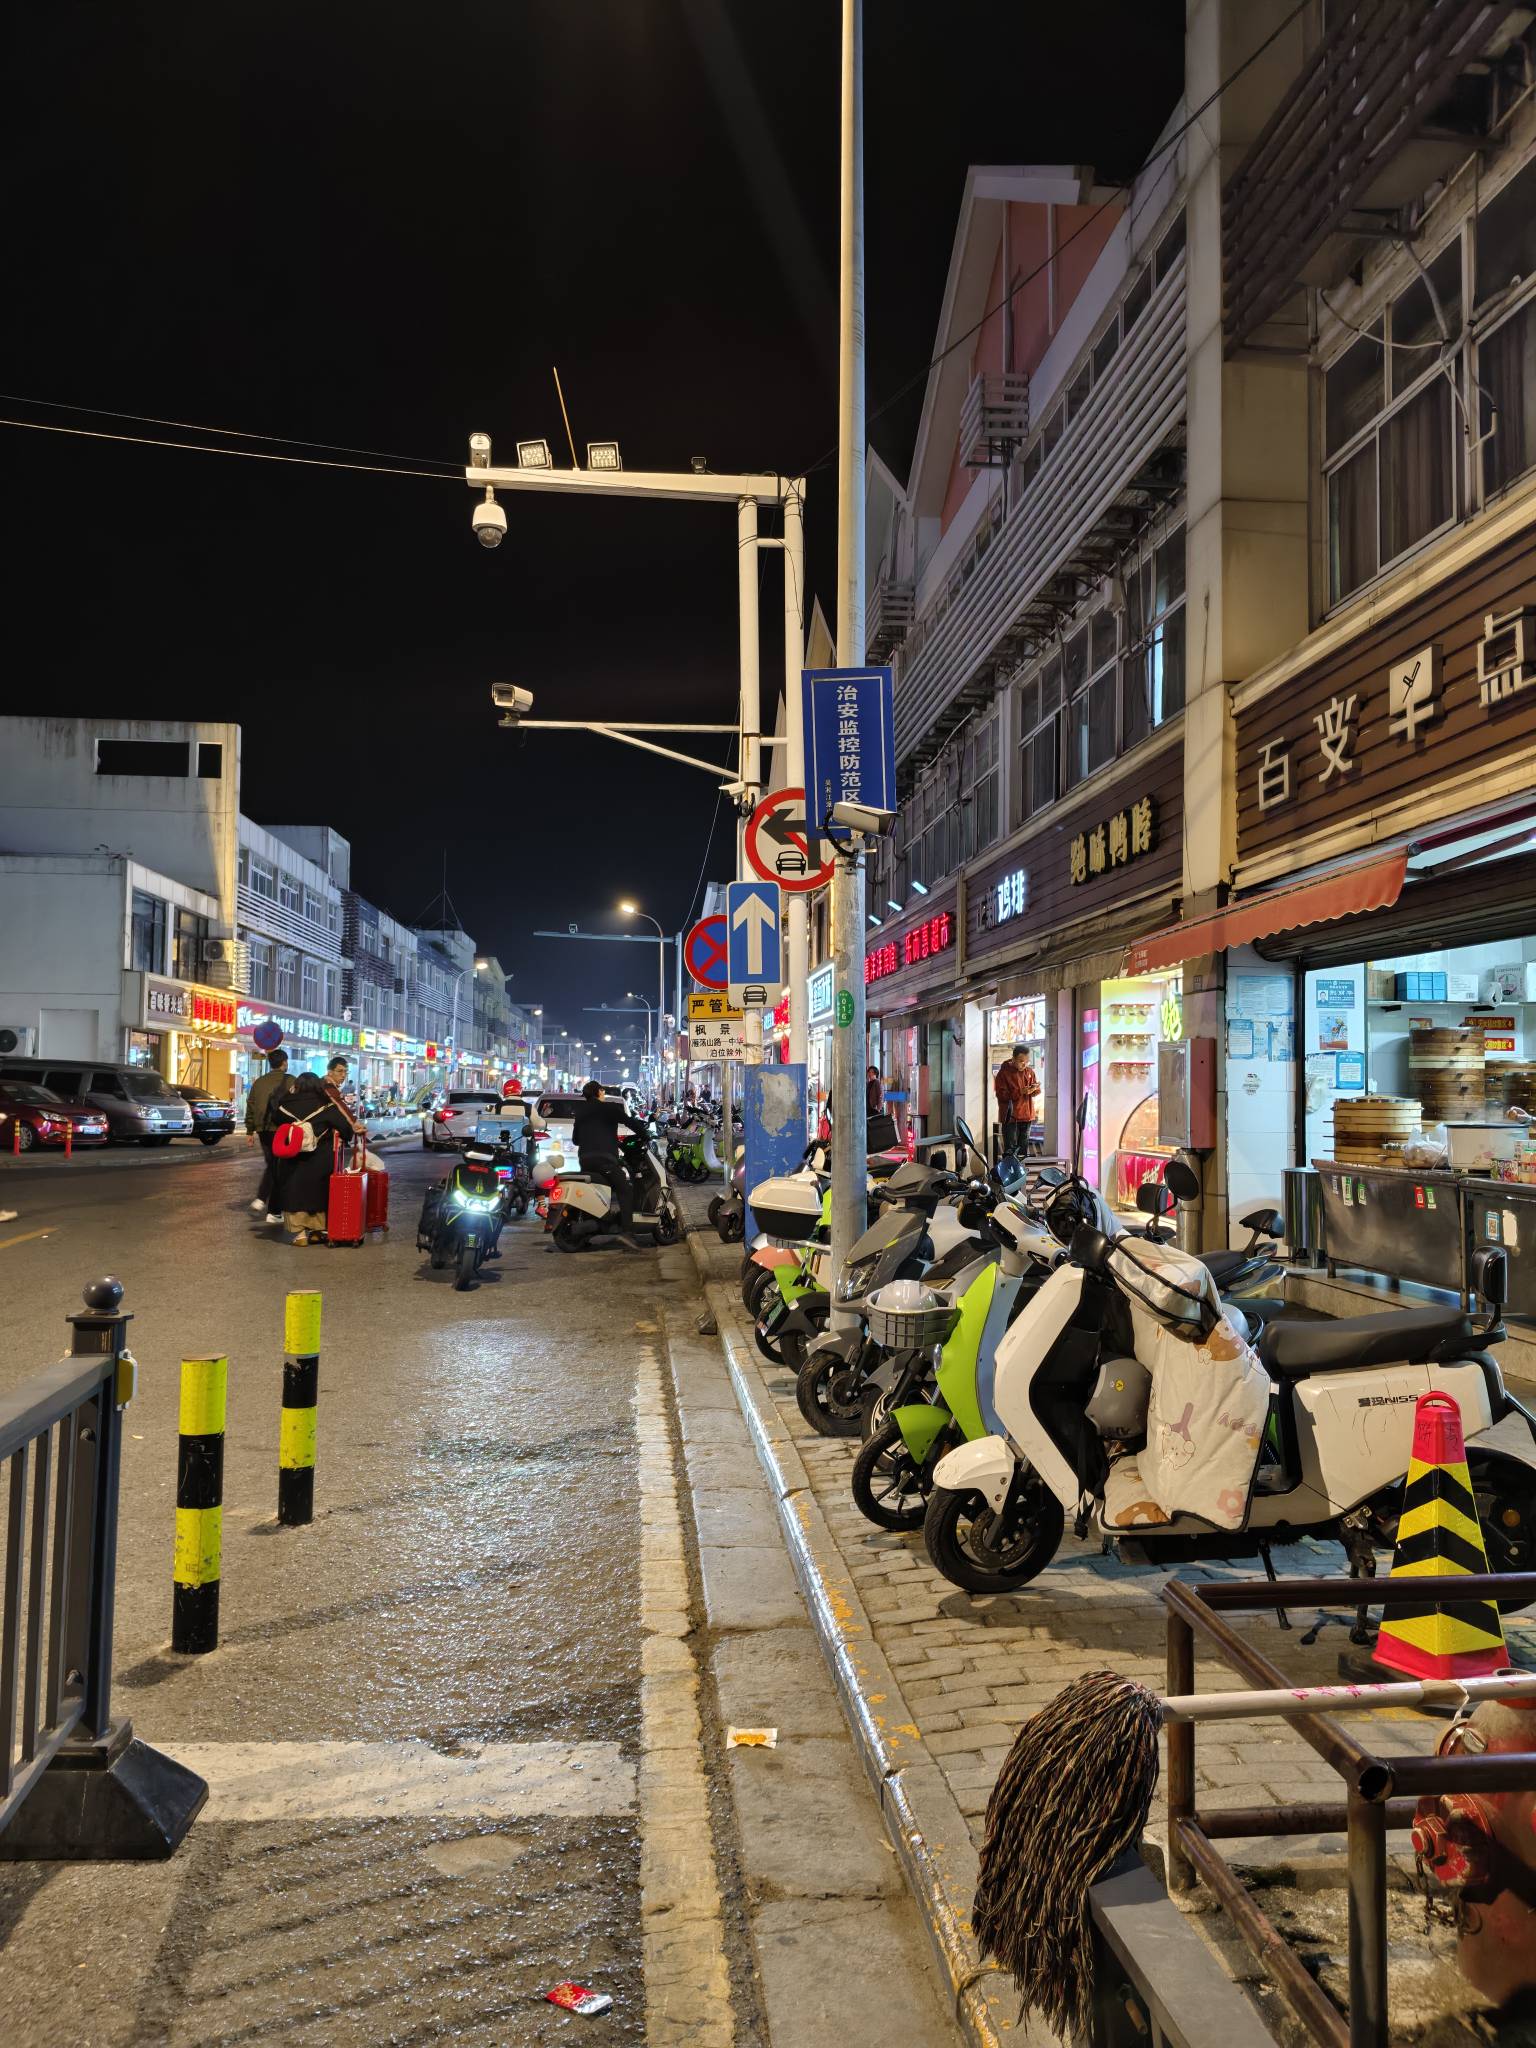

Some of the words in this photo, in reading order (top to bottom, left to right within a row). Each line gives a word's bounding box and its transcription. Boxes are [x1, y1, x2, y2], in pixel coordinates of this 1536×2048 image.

[836, 685, 862, 804] 治安监控防范区
